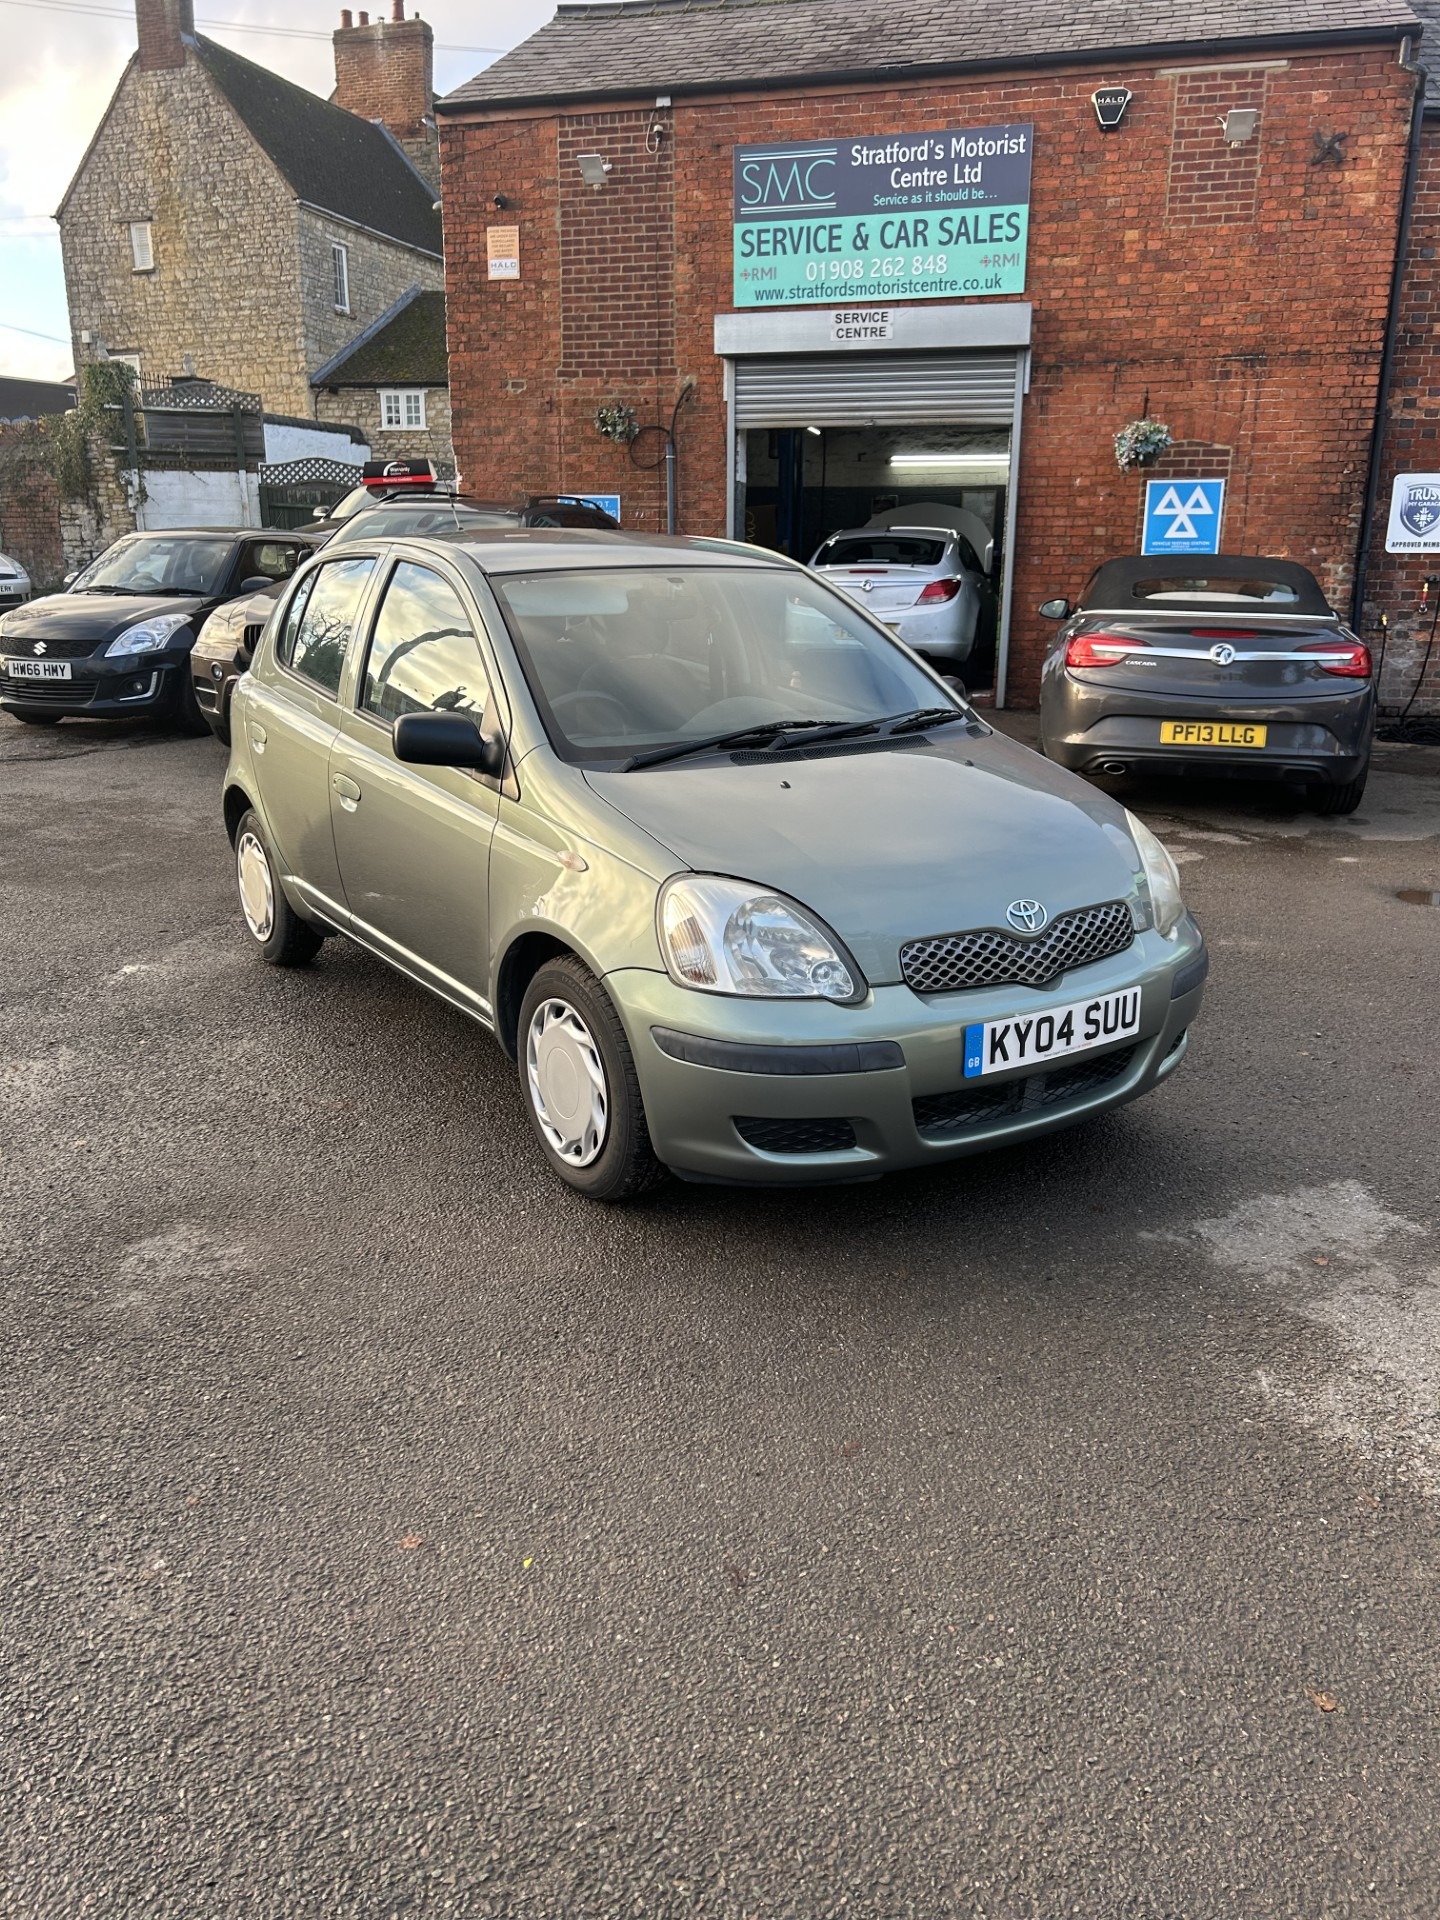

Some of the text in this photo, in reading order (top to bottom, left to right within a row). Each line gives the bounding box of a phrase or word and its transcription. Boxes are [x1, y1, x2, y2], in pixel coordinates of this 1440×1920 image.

[1097, 96, 1125, 104] HALO
[850, 133, 1027, 167] Stratford's Motorist
[741, 159, 837, 205] SMC
[890, 161, 983, 189] Centre Ltd
[873, 193, 909, 207] Service
[910, 192, 922, 204] as
[925, 190, 933, 203] it
[935, 188, 969, 202] should
[740, 211, 1021, 258] SERVICE & CAR SALES
[751, 252, 1021, 281] RMI 01908 262 848 RMI
[754, 272, 1003, 301] www.stratfordsmotoristcentre.co.uk
[834, 311, 889, 325] SERVICE
[836, 326, 887, 340] CENTRE
[1409, 487, 1440, 501] TRUS
[12, 662, 66, 678] HW66 HMY
[1172, 724, 1255, 744] PF13 LLG
[989, 992, 1138, 1065] KY04 SUU
[968, 1056, 980, 1068] GB
